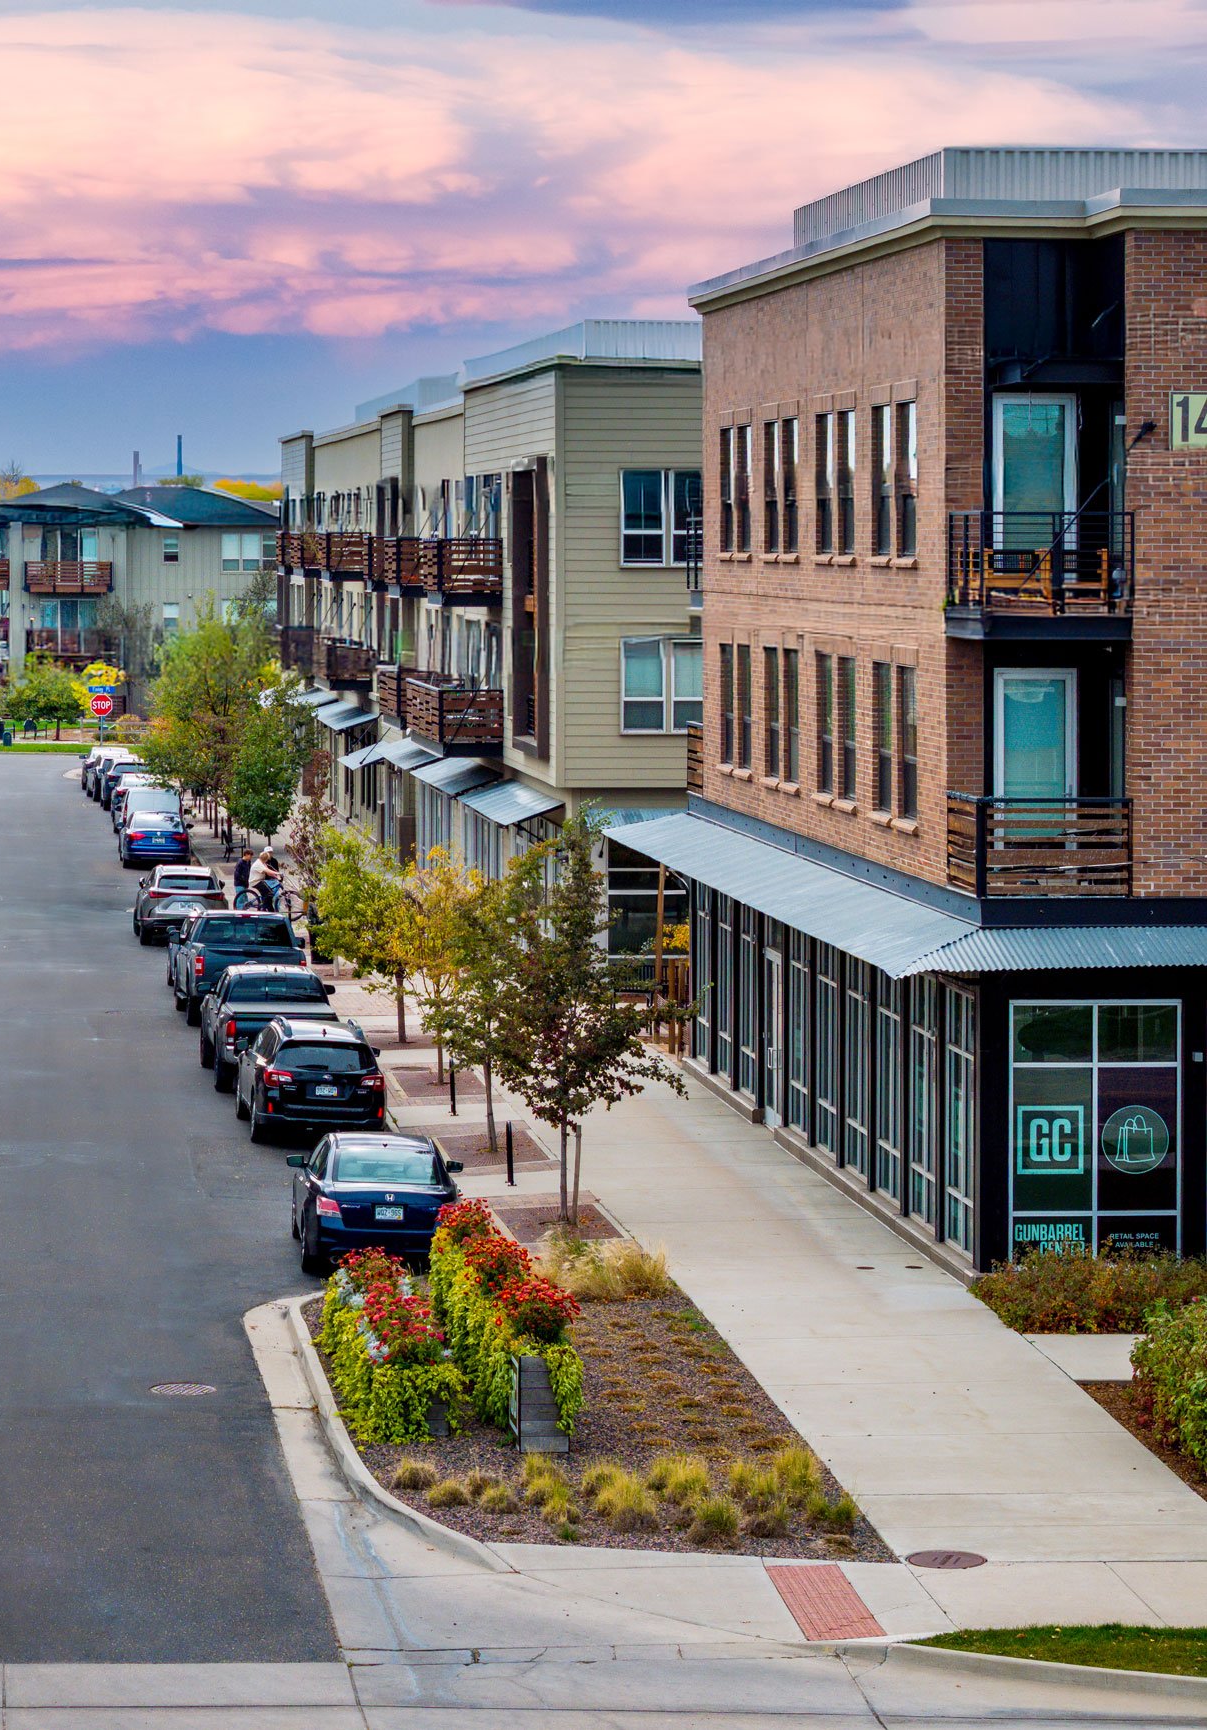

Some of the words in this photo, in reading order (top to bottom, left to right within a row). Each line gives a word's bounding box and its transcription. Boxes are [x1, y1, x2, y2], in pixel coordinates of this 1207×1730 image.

[92, 700, 111, 710] STOP
[1029, 1118, 1072, 1162] GC
[1014, 1223, 1086, 1242] GUNBARREL
[1136, 1232, 1159, 1240] SPACE
